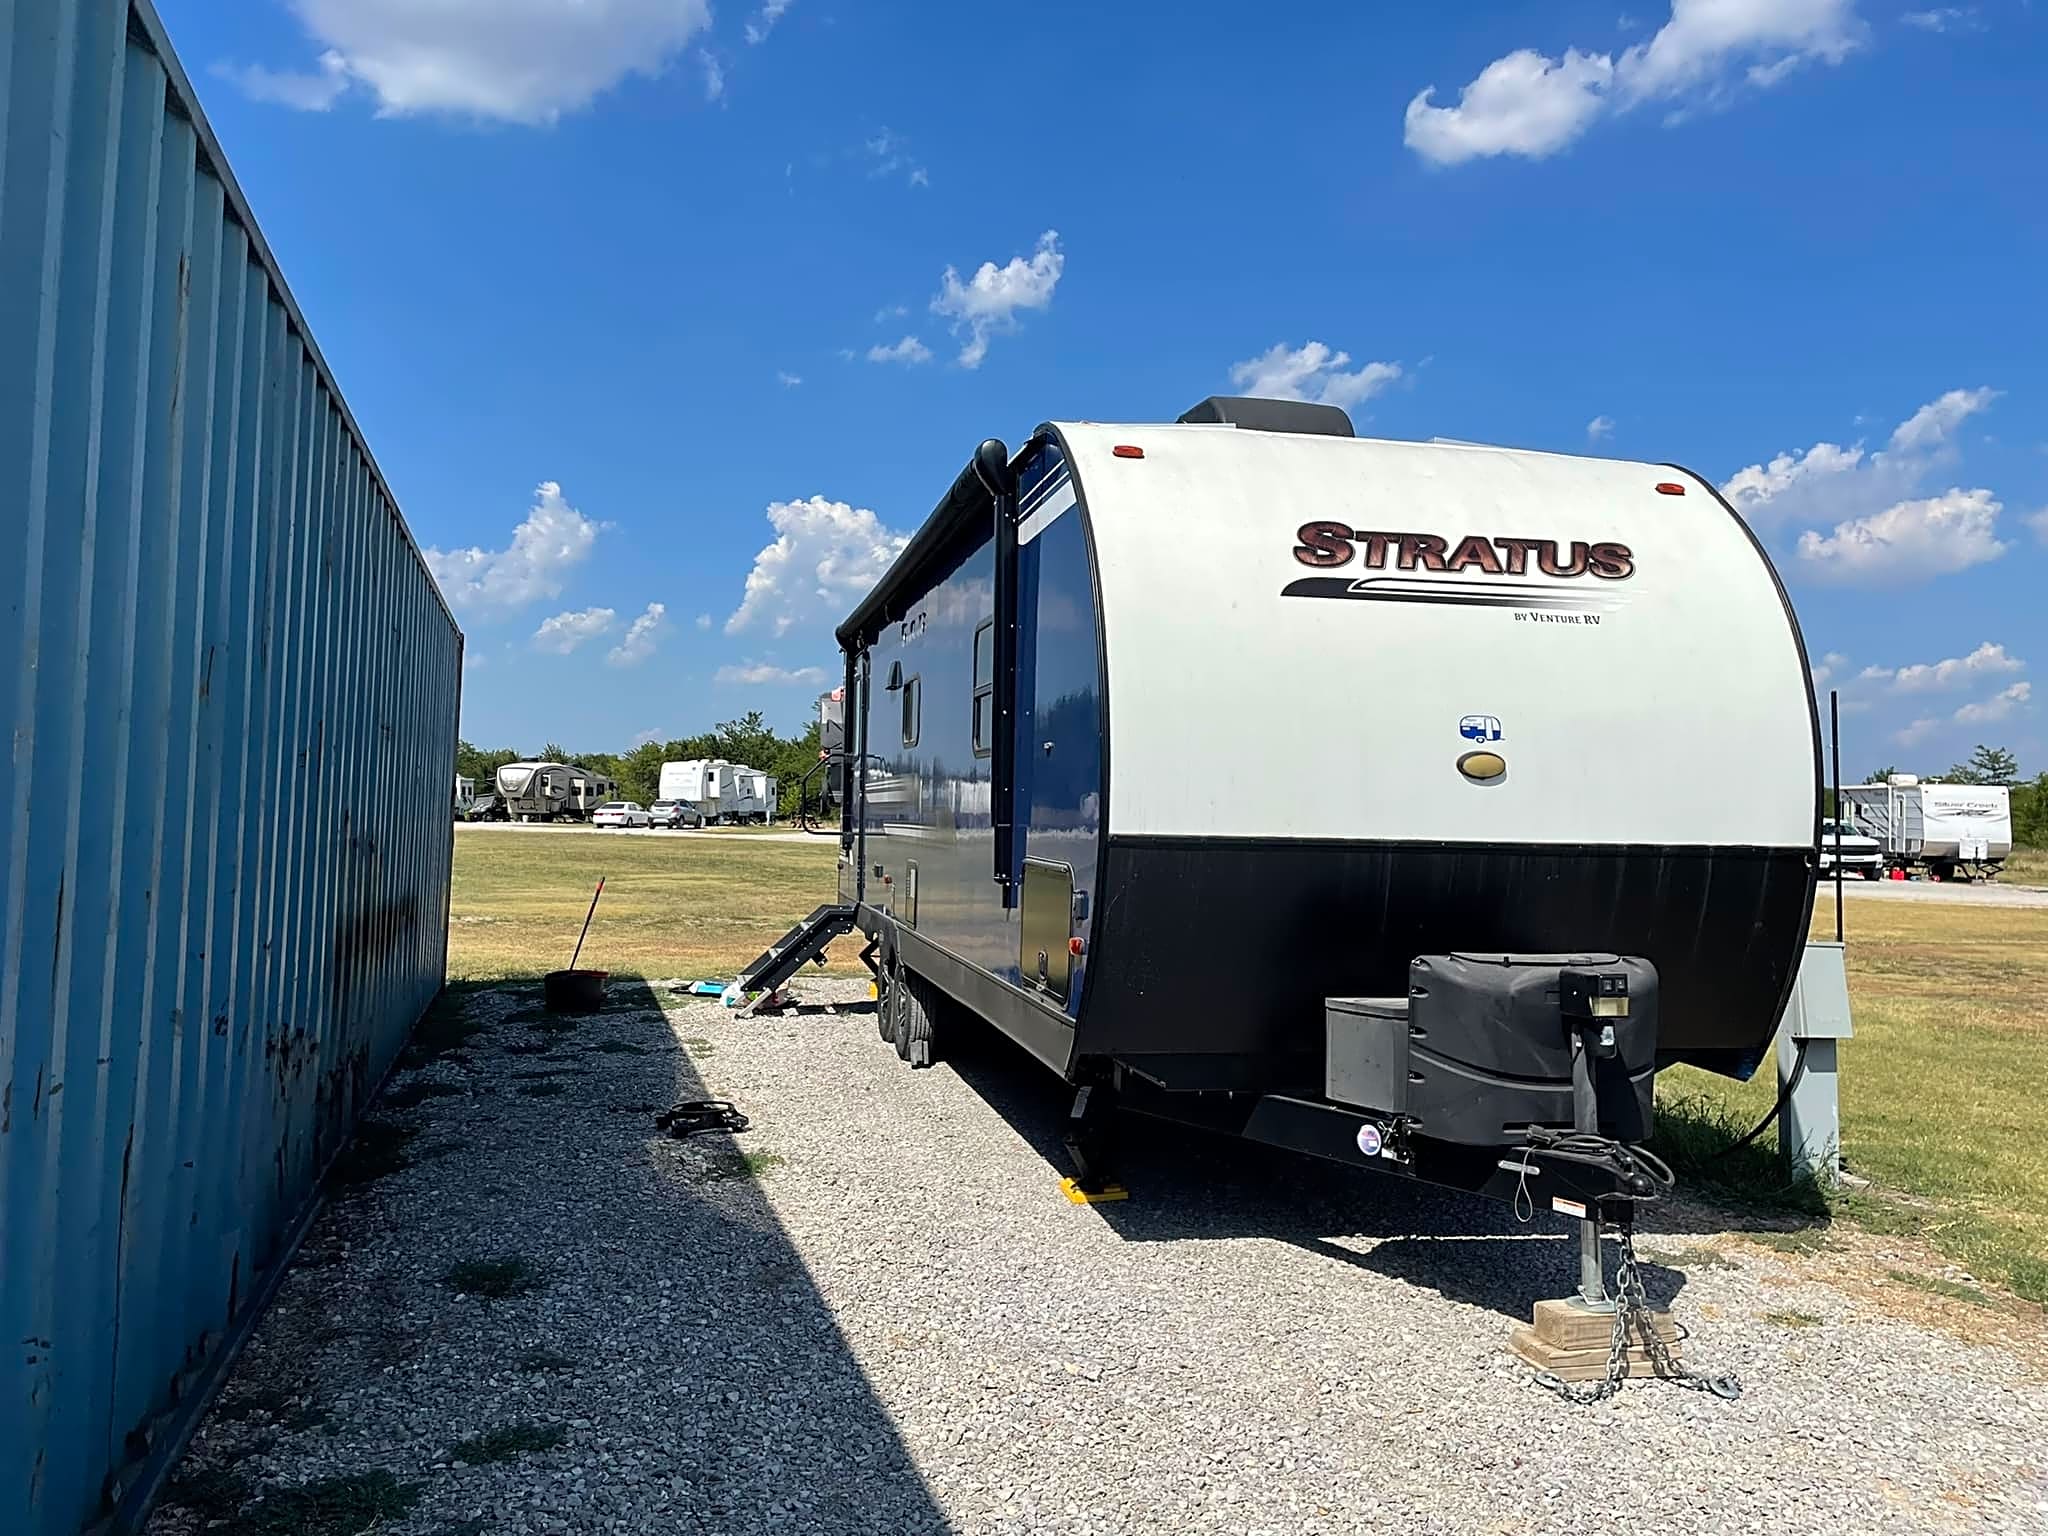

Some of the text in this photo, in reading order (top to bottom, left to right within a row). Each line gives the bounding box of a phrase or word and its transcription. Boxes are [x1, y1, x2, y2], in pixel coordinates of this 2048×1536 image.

[1292, 520, 1636, 580] STRATUS
[1514, 612, 1600, 624] BY VENTURE RV
